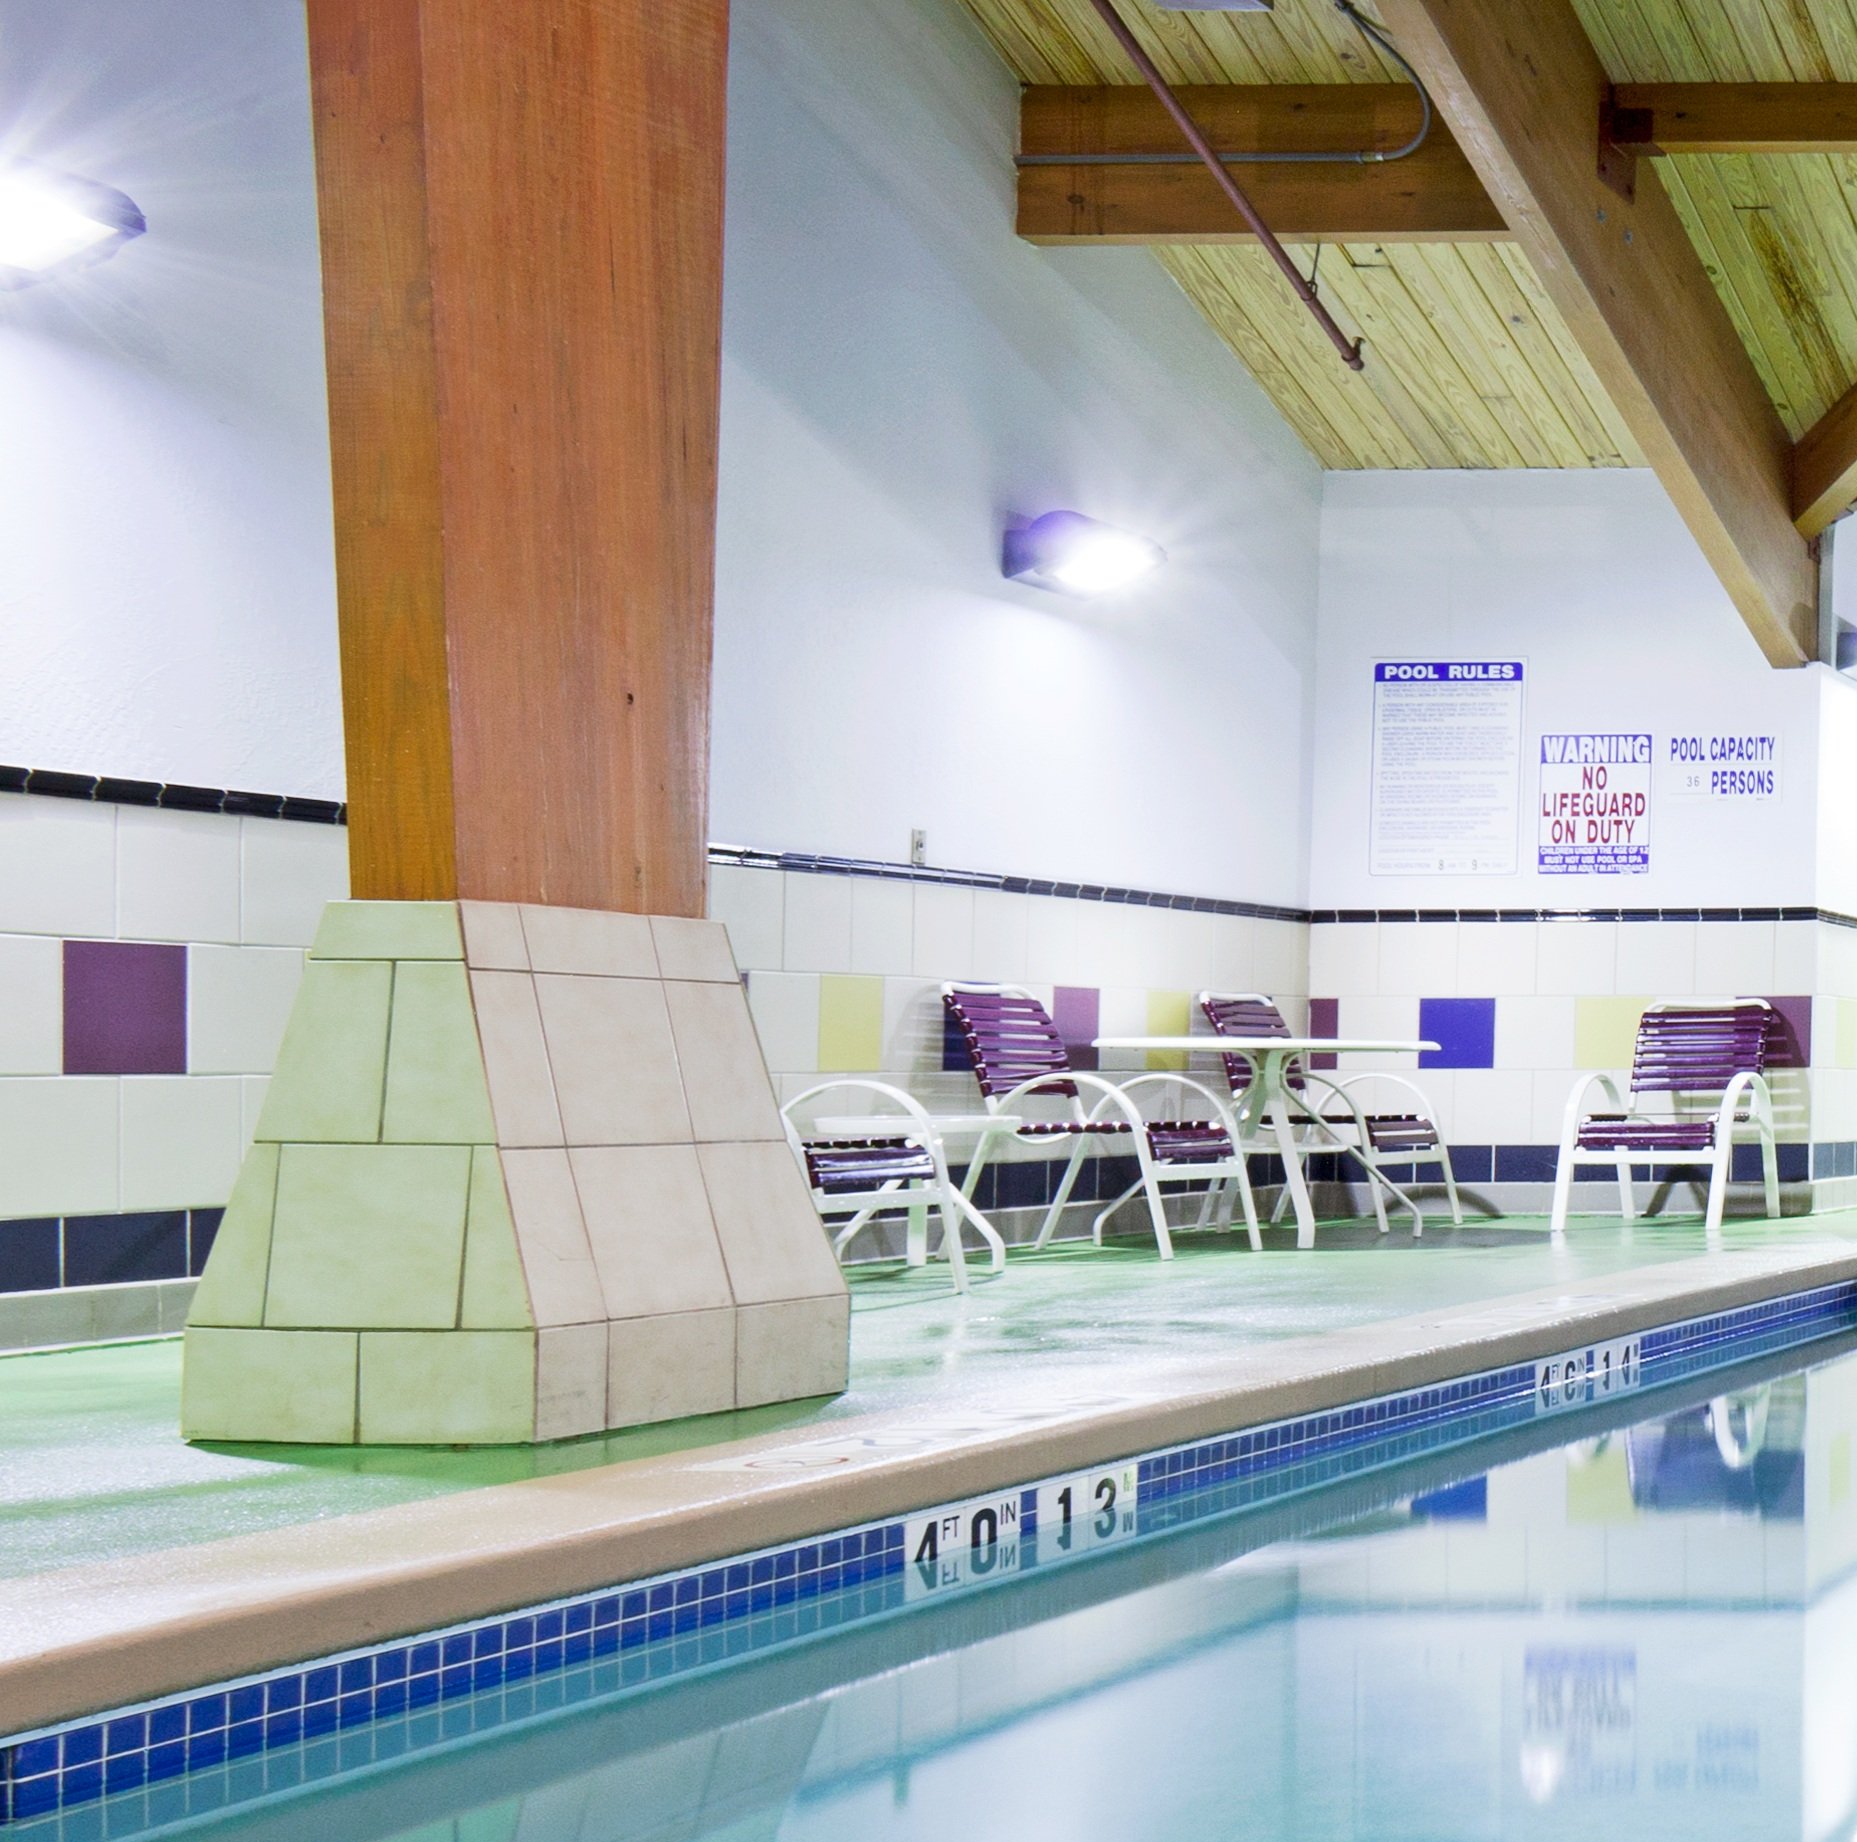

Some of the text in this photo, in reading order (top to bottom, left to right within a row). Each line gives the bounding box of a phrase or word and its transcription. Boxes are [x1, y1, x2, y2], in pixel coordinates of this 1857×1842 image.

[1384, 665, 1515, 679] POOL RULES
[1543, 735, 1650, 763] WARNING
[1670, 736, 1775, 761] POOL CAPACITY
[1582, 766, 1607, 790] NO
[1712, 770, 1774, 794] PERSONS
[1543, 792, 1646, 817] LIFEGUARD
[1552, 819, 1635, 844] ON DUTY
[1544, 855, 1643, 864] MUST NOT USE POOL OR SPA
[943, 1516, 960, 1541] FT
[1000, 1501, 1016, 1526] IN
